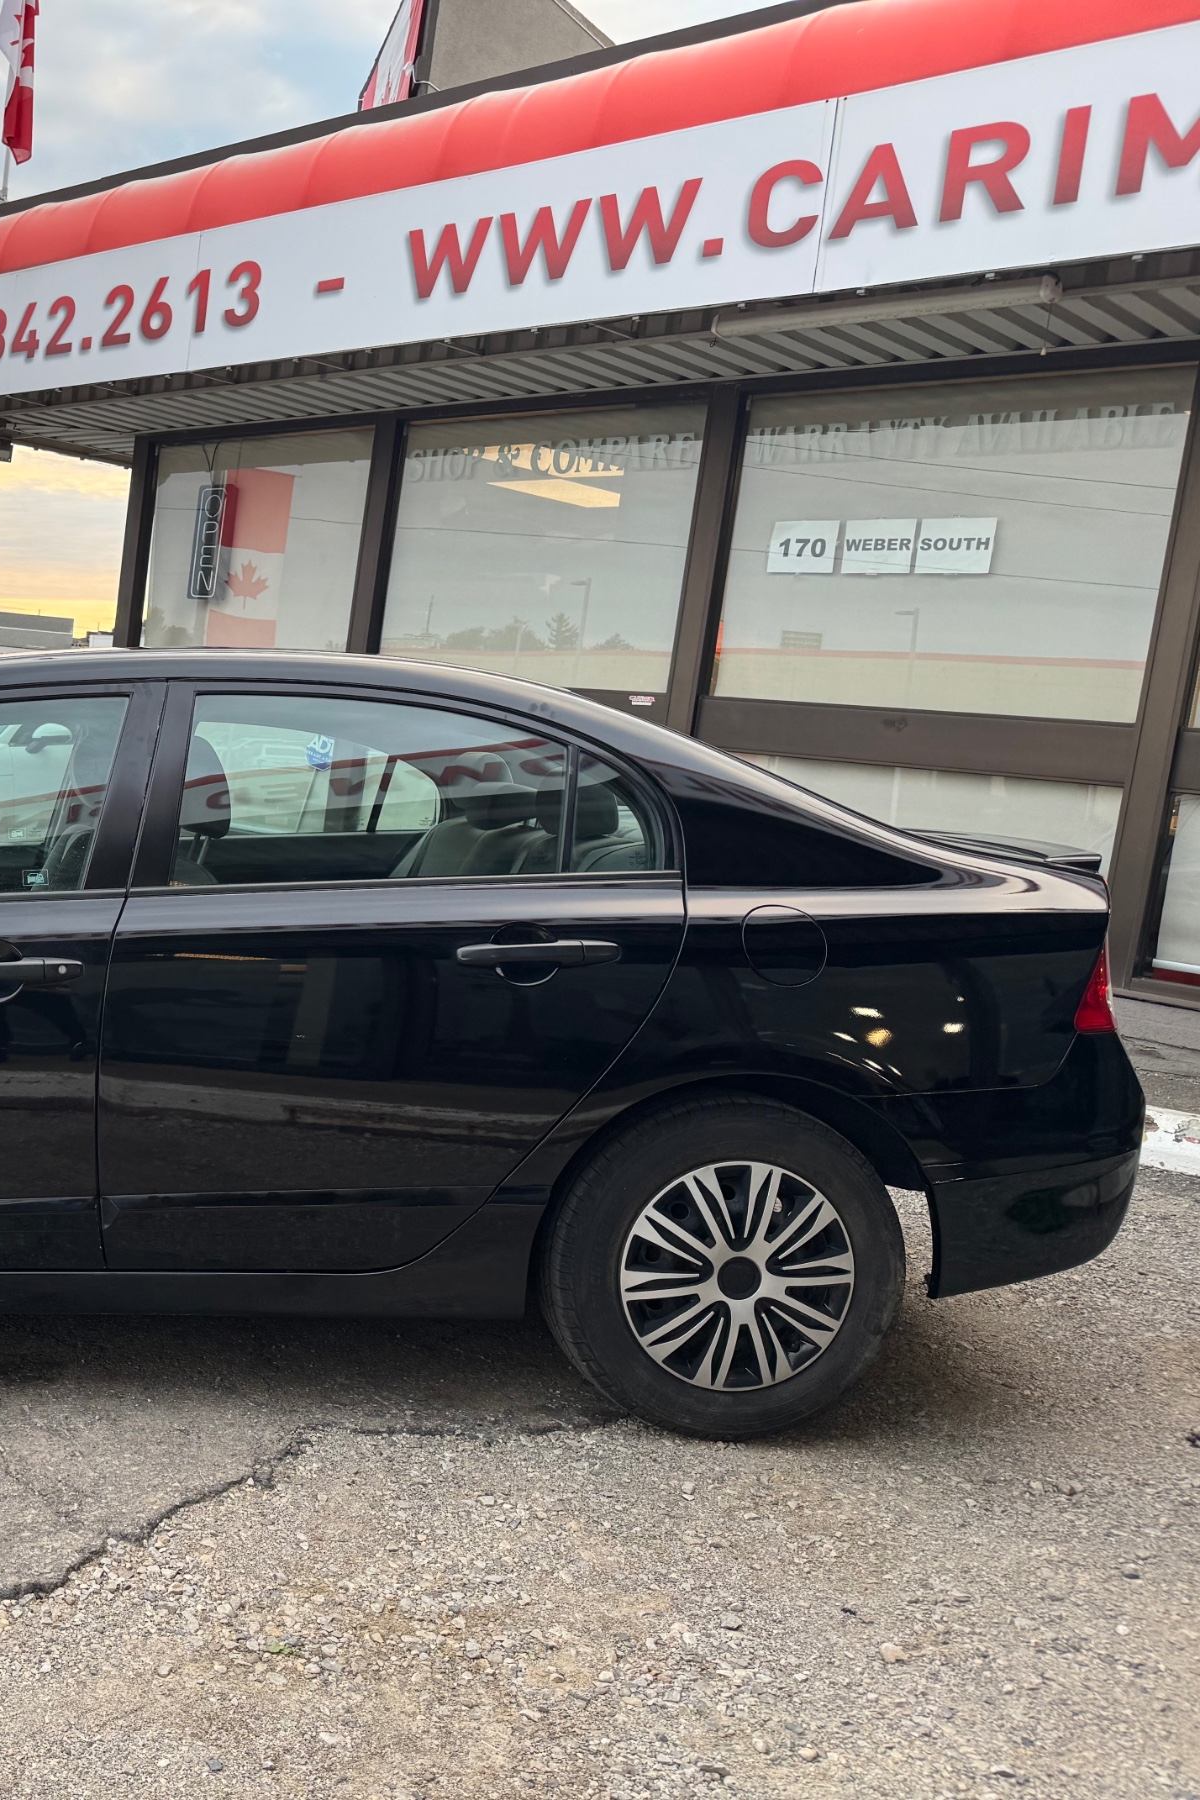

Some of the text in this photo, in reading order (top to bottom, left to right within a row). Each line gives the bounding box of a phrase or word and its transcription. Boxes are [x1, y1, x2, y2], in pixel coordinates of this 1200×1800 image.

[408, 92, 1200, 299] WWW.CARIM
[405, 432, 696, 483] SHOP & COMPARE
[752, 402, 1175, 464] WARRANTY AVAILABLE
[196, 494, 222, 592] OPEN
[778, 537, 991, 558] 170 WEBER SOUTH
